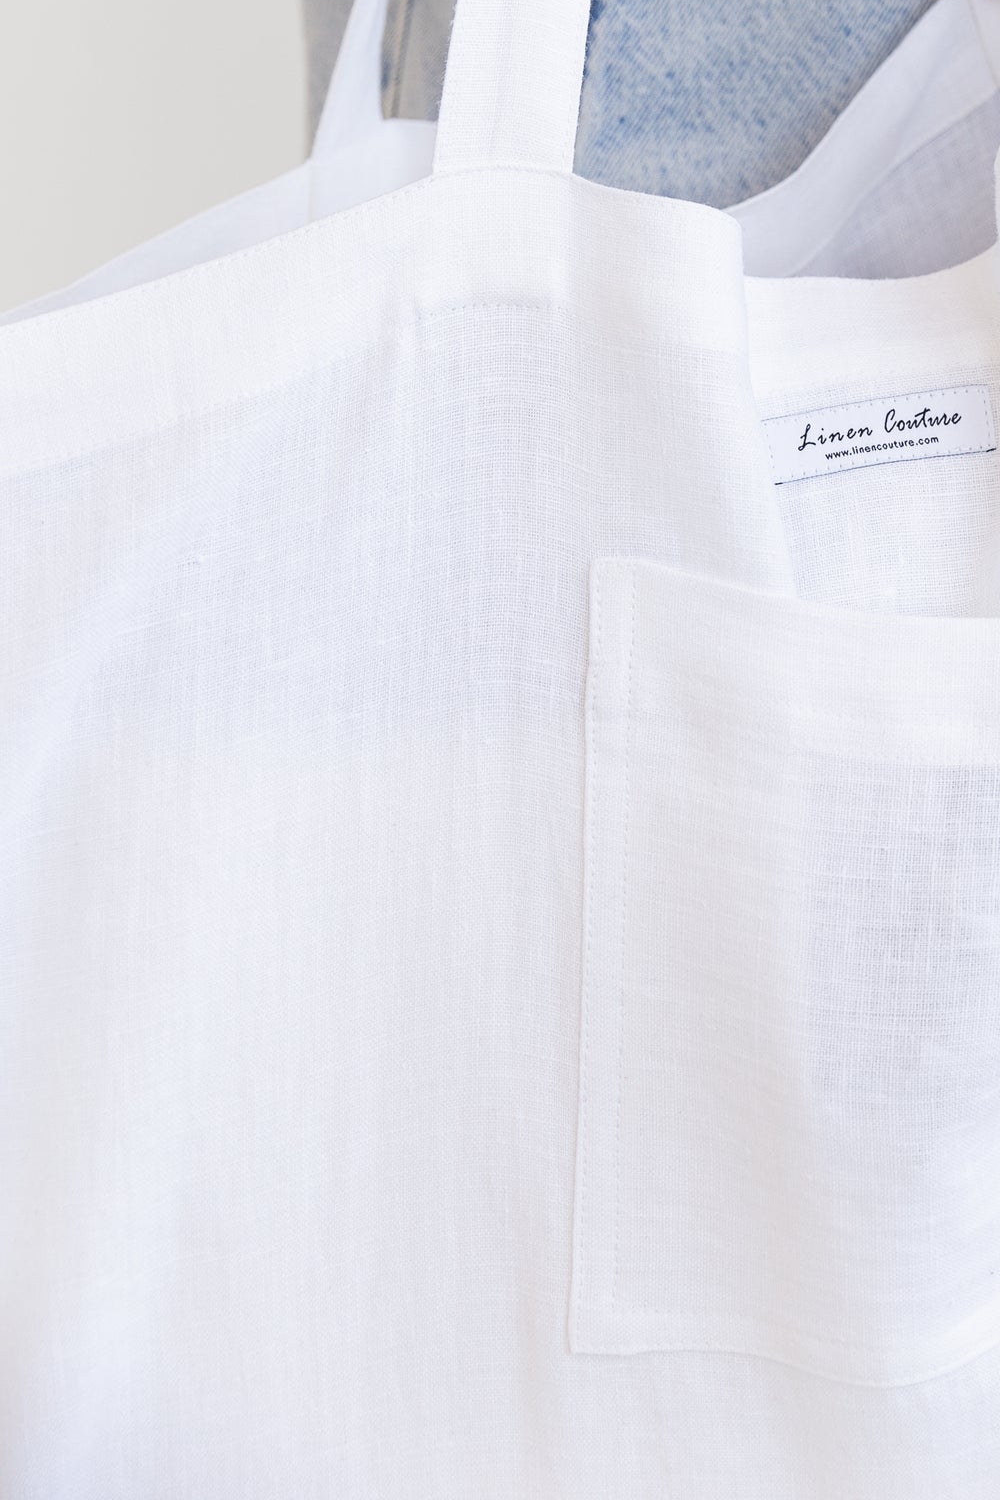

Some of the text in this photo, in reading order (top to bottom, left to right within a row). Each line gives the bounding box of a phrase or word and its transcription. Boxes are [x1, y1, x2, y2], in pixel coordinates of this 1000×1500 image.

[797, 407, 962, 452] Linen Couture
[825, 435, 939, 461] www.linencouture.com
